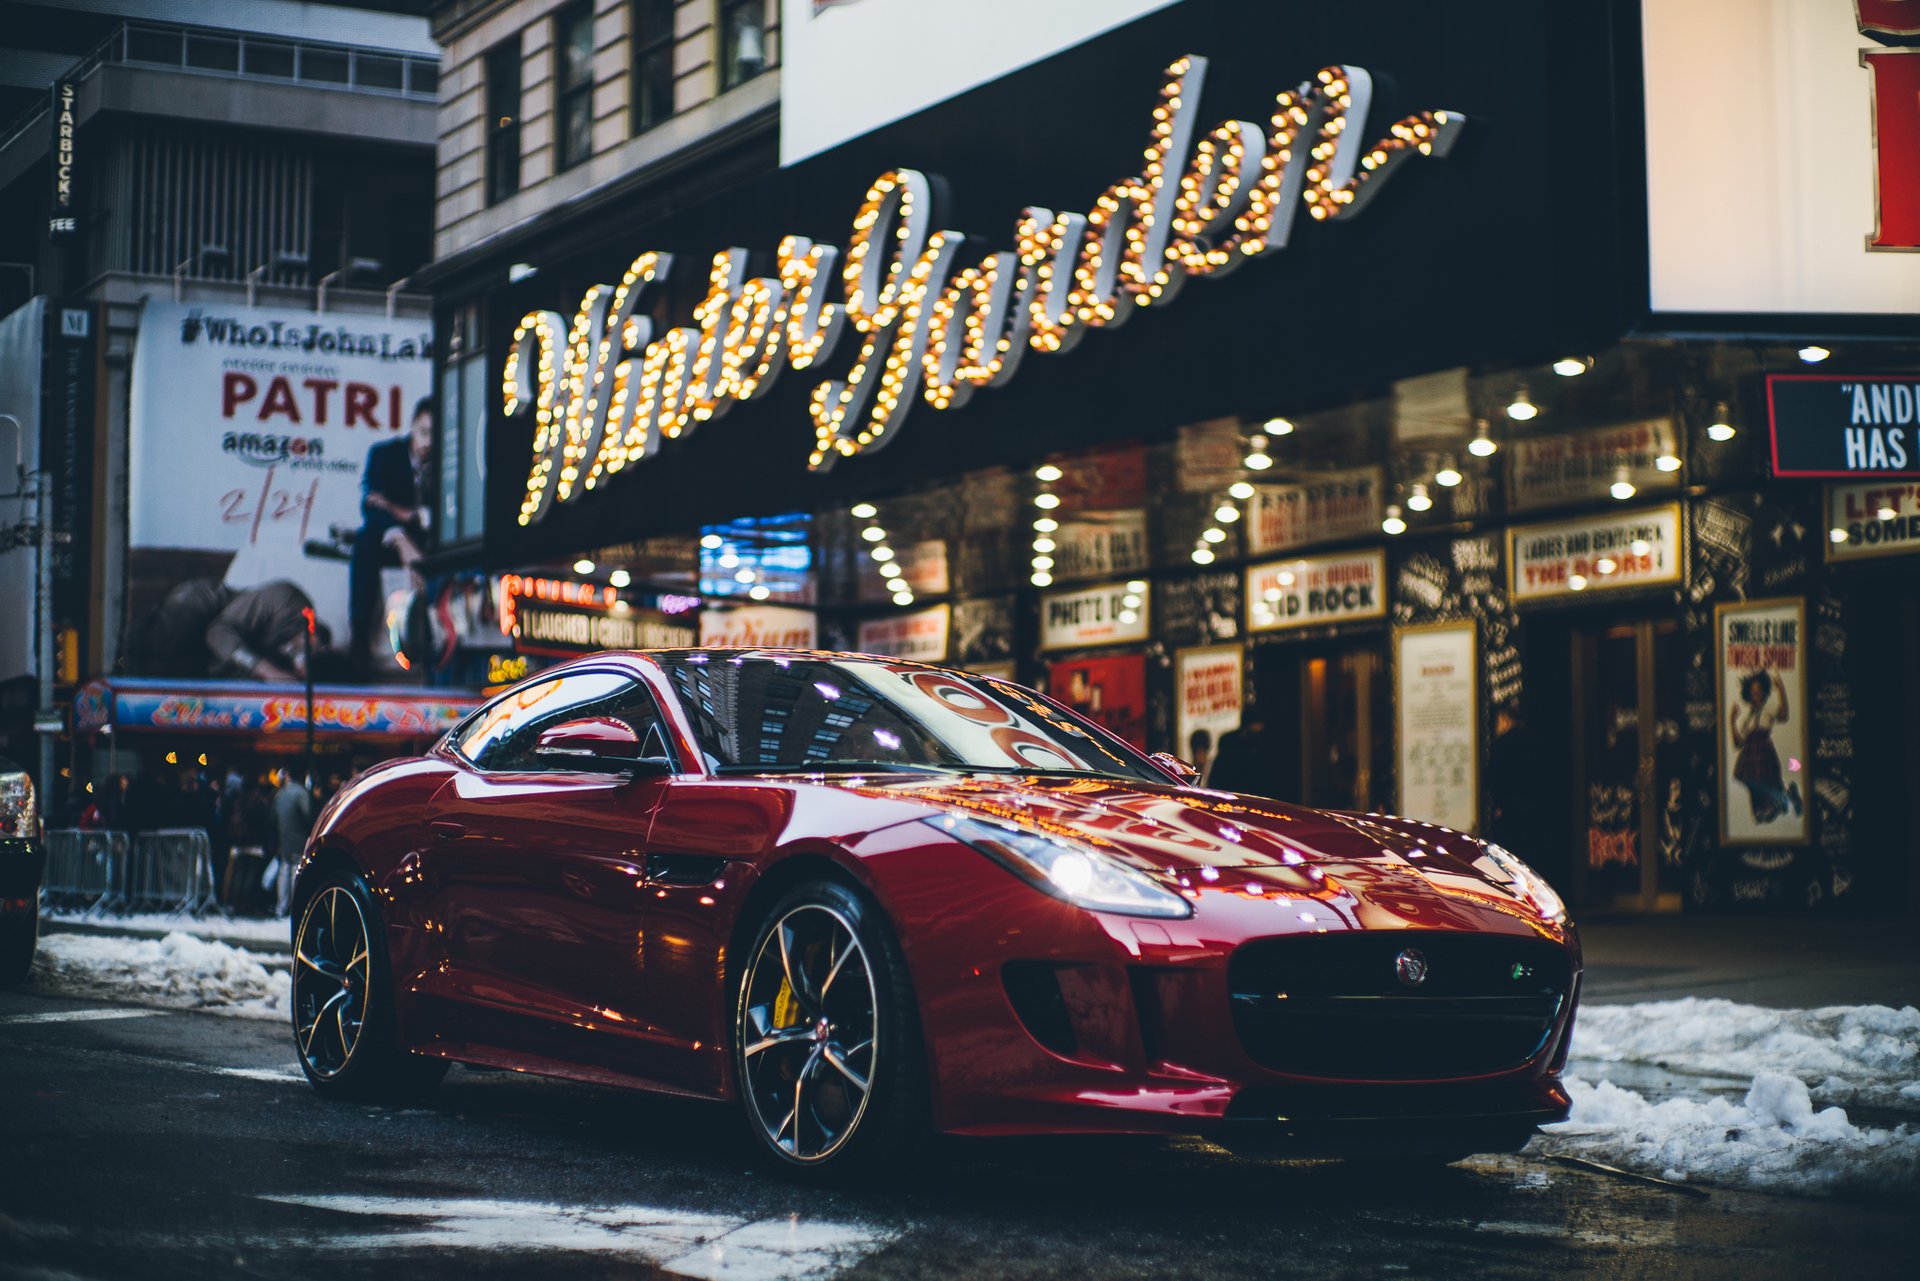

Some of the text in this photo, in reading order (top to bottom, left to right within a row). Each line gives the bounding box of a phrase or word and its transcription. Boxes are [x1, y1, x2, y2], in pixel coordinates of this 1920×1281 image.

[503, 235, 845, 526] Winter
[808, 54, 1467, 471] Garden
[222, 432, 323, 457] amazon
[1845, 427, 1907, 470] HAS
[1525, 562, 1564, 587] THE
[1308, 585, 1373, 614] ROCK
